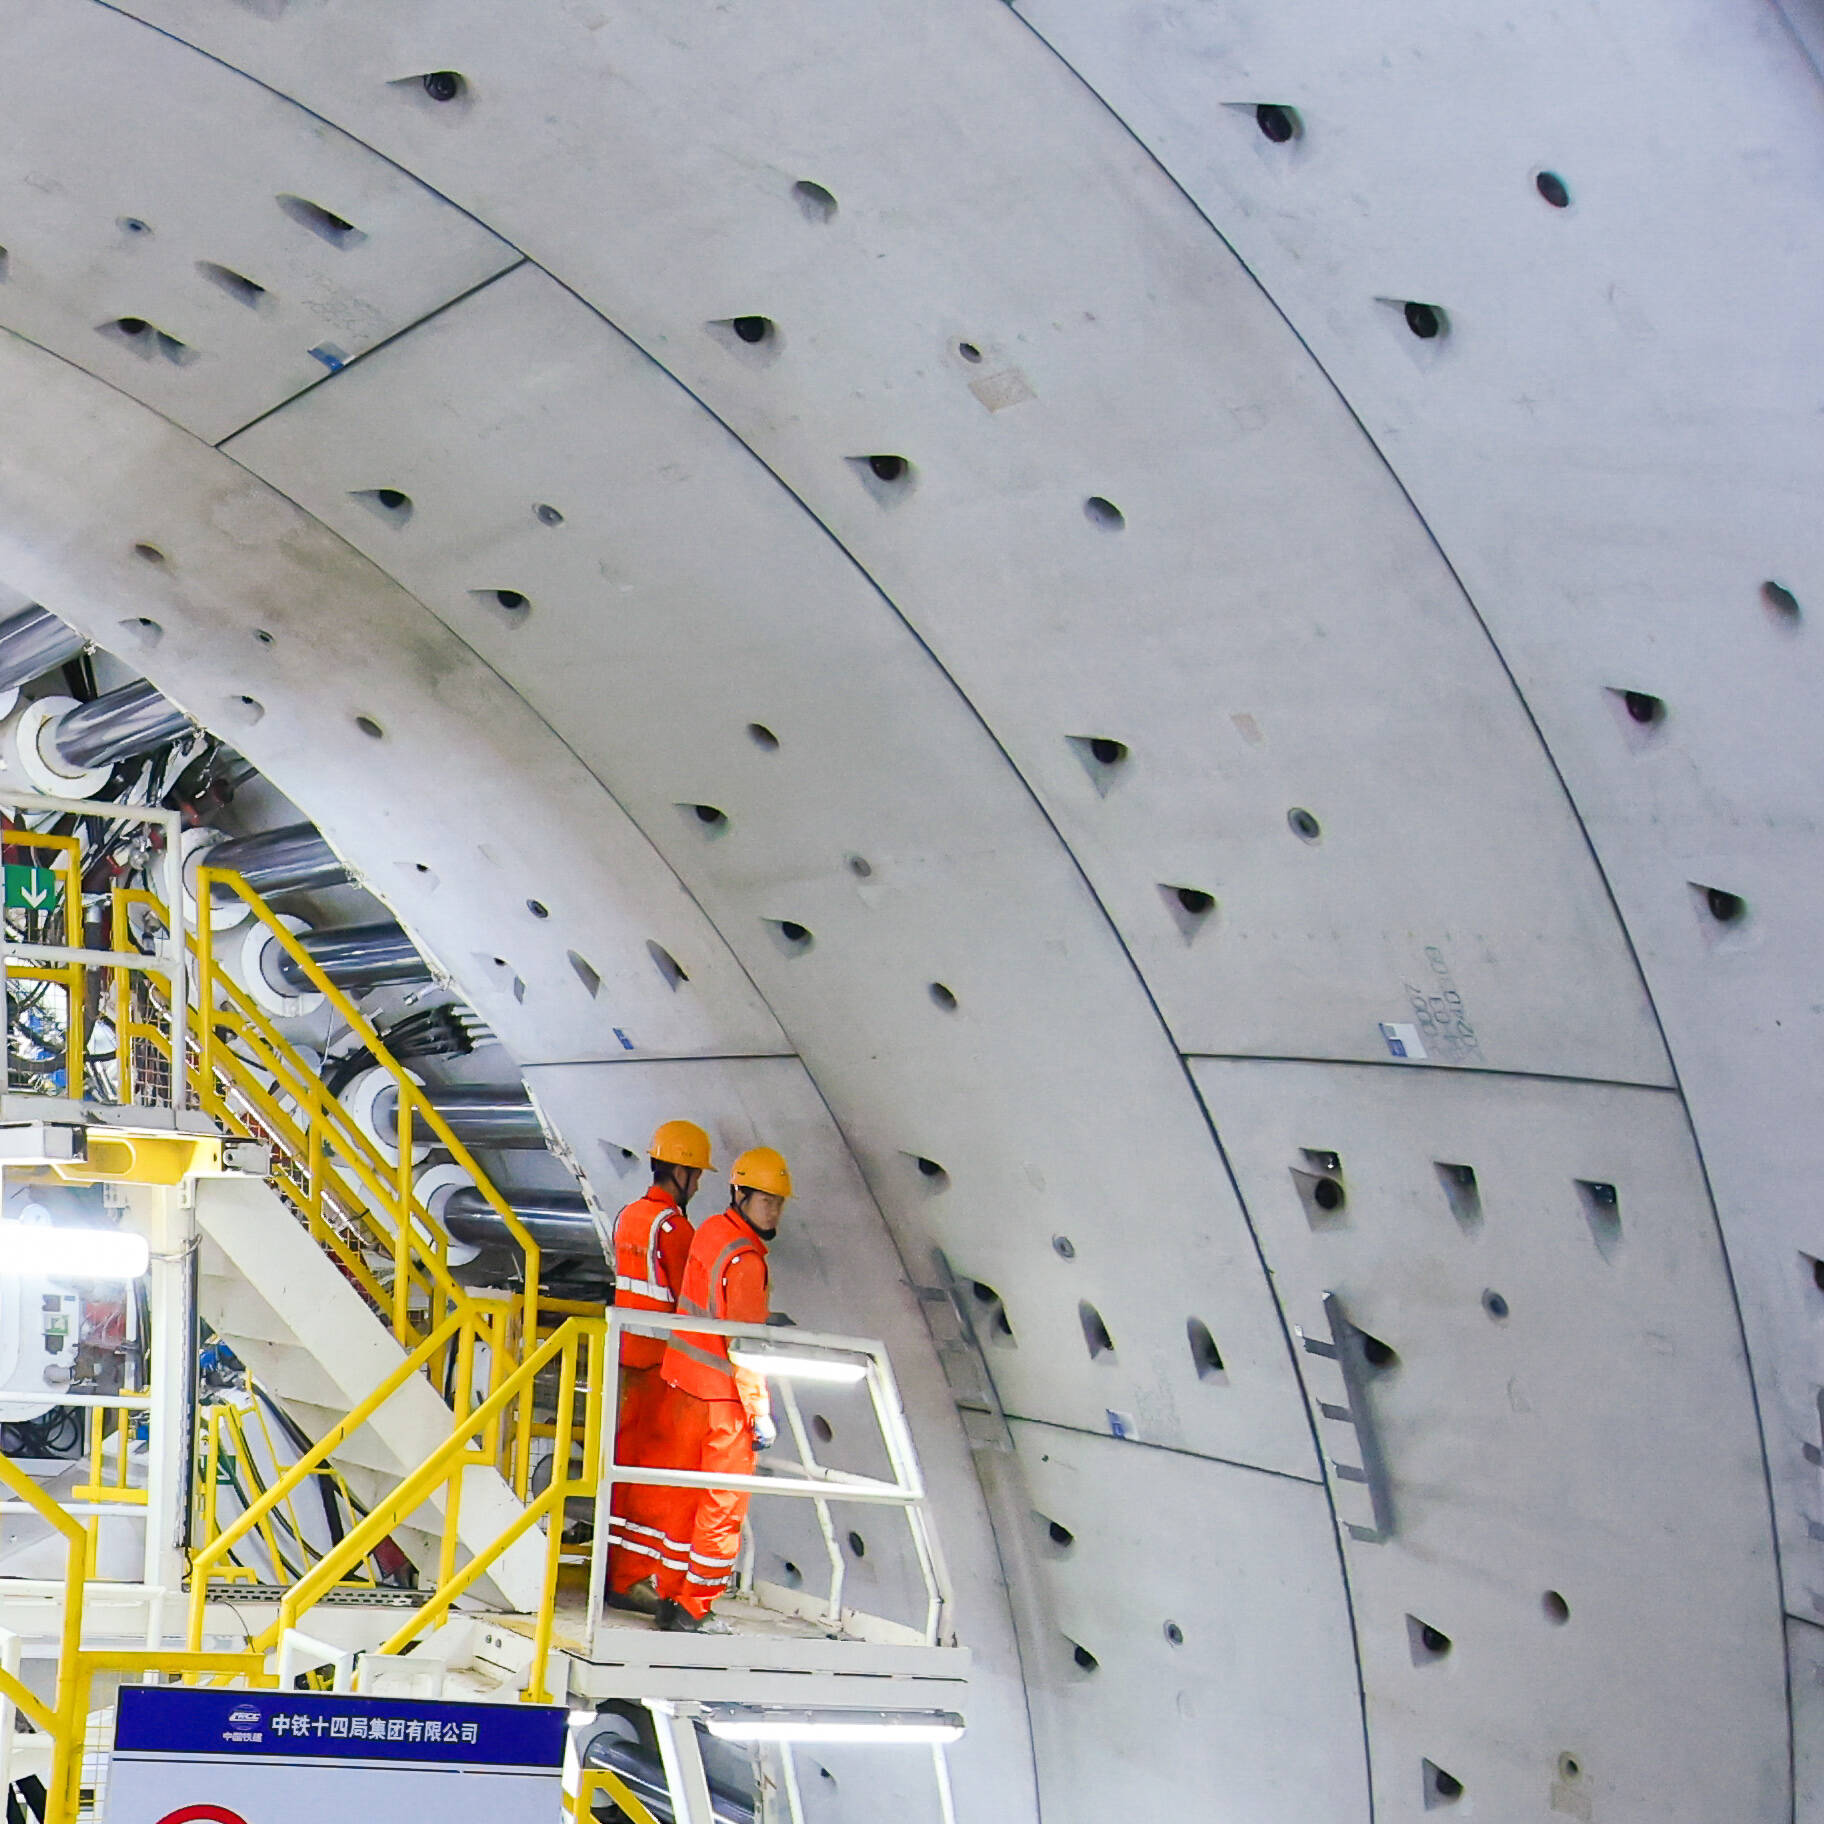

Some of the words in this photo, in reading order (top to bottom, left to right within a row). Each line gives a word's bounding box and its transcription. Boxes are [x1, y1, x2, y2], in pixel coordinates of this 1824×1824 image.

[270, 1713, 479, 1746] 中铁十四局集团有限公司
